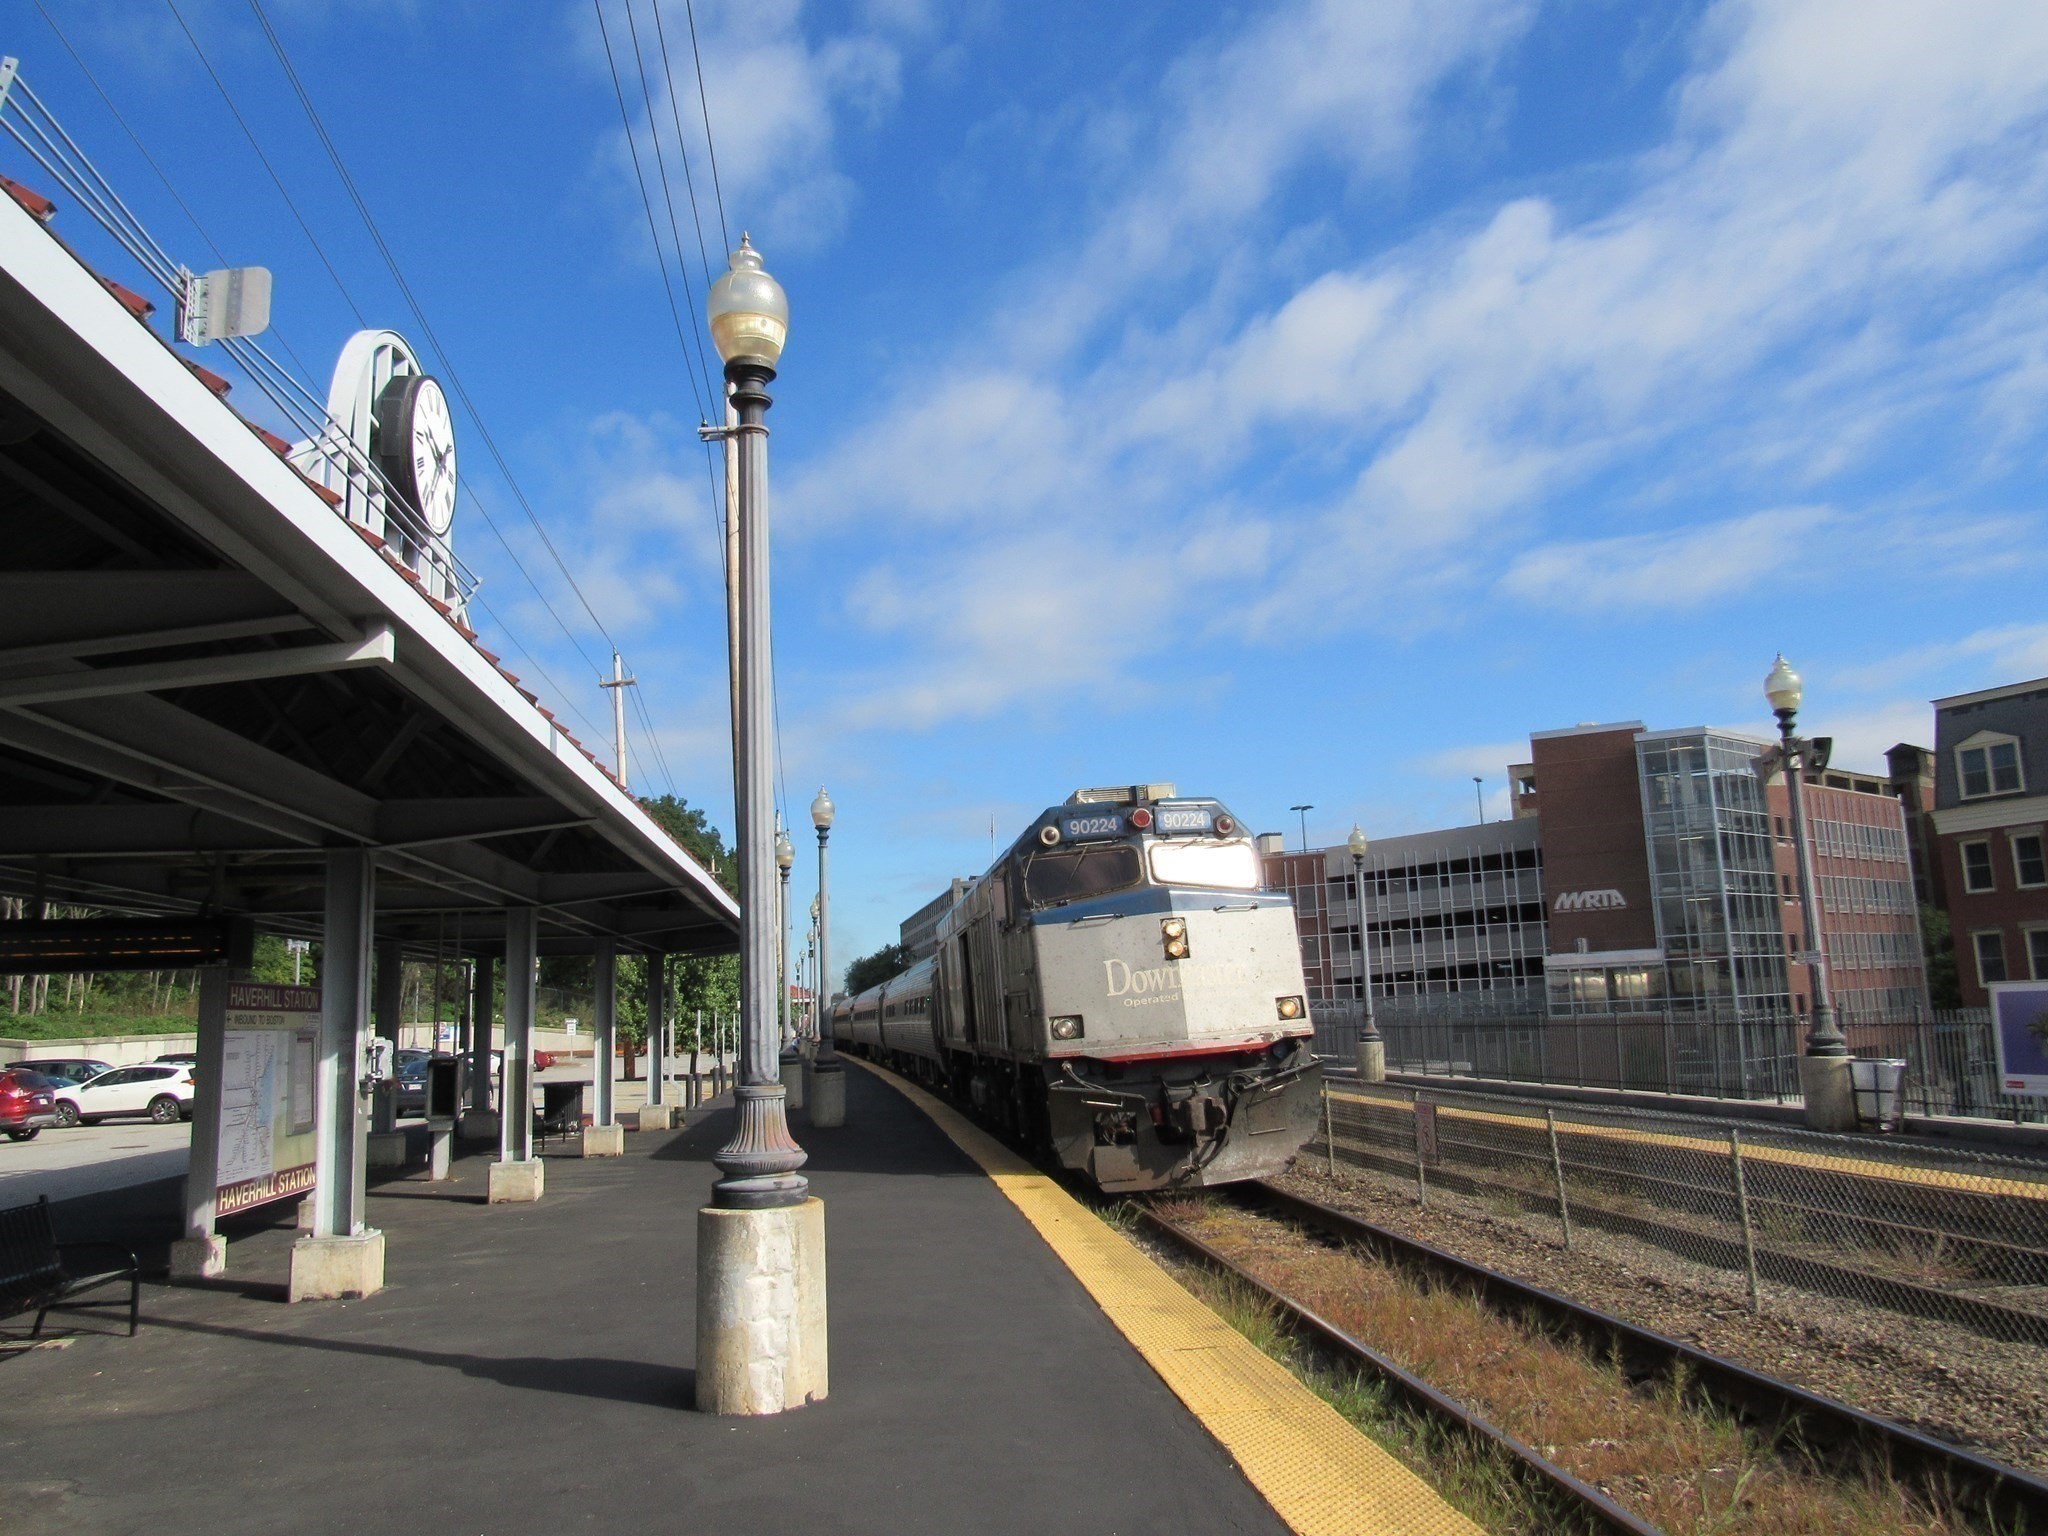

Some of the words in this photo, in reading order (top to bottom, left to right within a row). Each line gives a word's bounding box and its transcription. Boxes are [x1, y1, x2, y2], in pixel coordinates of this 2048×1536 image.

[1070, 817, 1118, 835] 90224
[1163, 812, 1206, 828] 90224
[230, 986, 282, 1008] HAVERHILL
[284, 989, 319, 1009] STATION
[1123, 993, 1179, 1008] Operated
[219, 1176, 277, 1212] HAVERHILL
[278, 1165, 316, 1194] STATION
